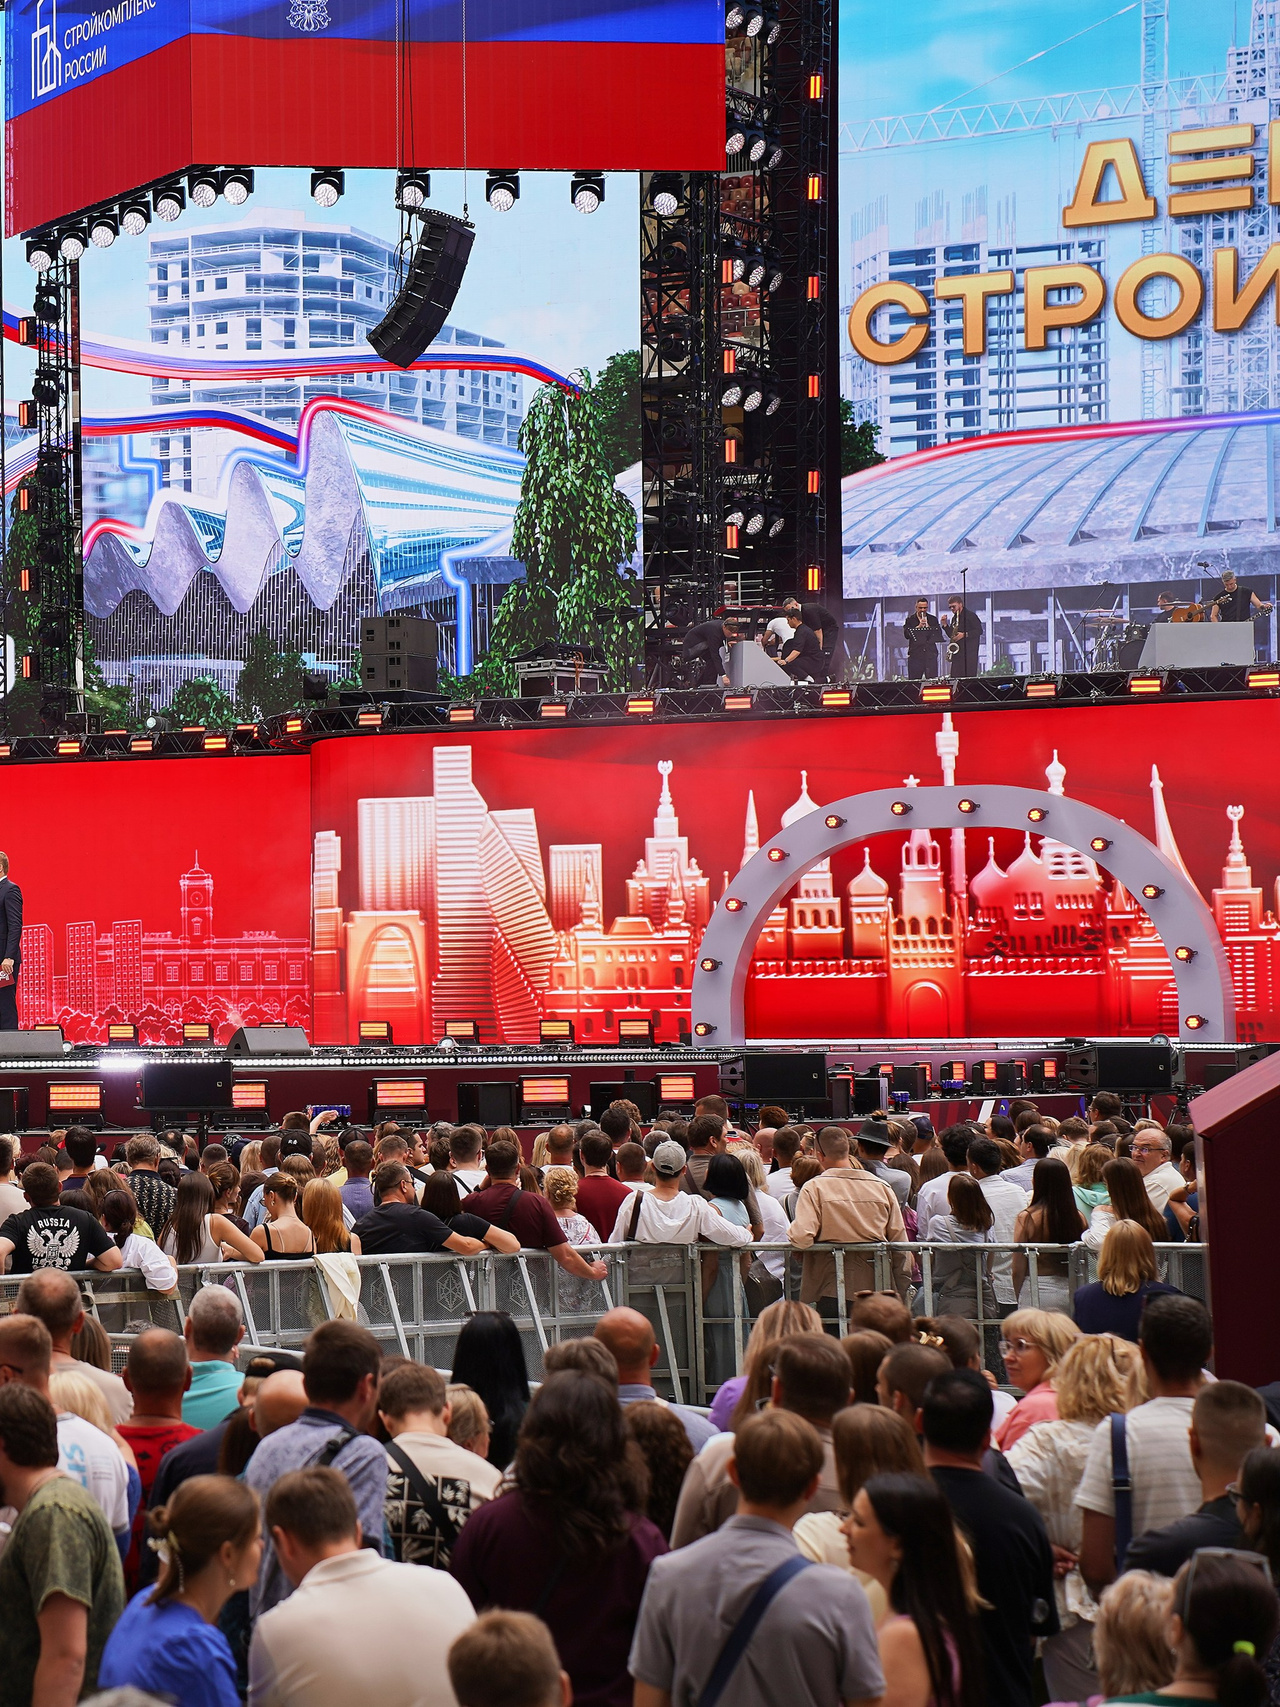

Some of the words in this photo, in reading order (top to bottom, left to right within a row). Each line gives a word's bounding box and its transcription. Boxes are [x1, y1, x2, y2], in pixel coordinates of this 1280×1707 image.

[64, 45, 107, 83] РОССИИ
[1062, 119, 1280, 228] ДЕ
[37, 1217, 71, 1229] RUSSIA
